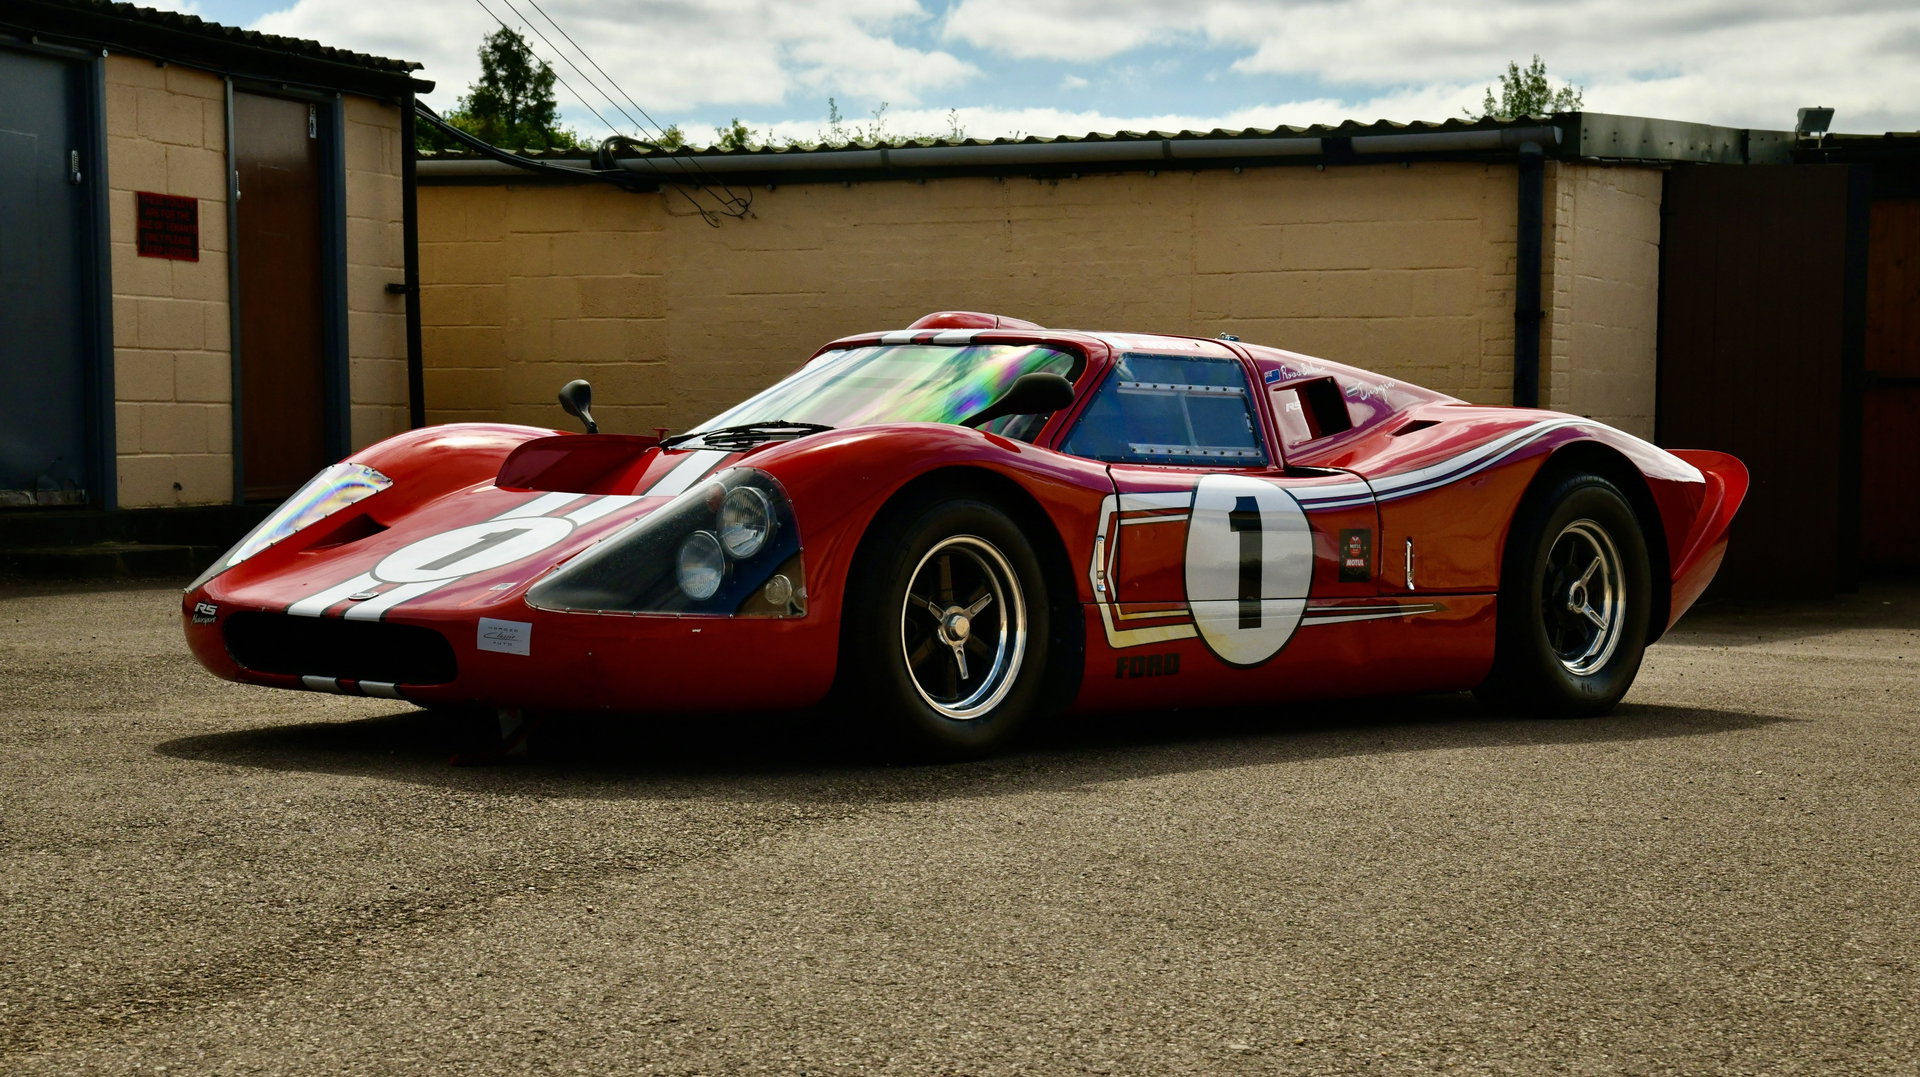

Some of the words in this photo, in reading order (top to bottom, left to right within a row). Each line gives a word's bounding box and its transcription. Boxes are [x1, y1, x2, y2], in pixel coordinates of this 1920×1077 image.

[415, 528, 533, 570] 1
[1229, 496, 1262, 629] 1
[1346, 559, 1364, 567] MOTUL
[195, 602, 218, 615] RS
[1115, 653, 1180, 680] FORD
